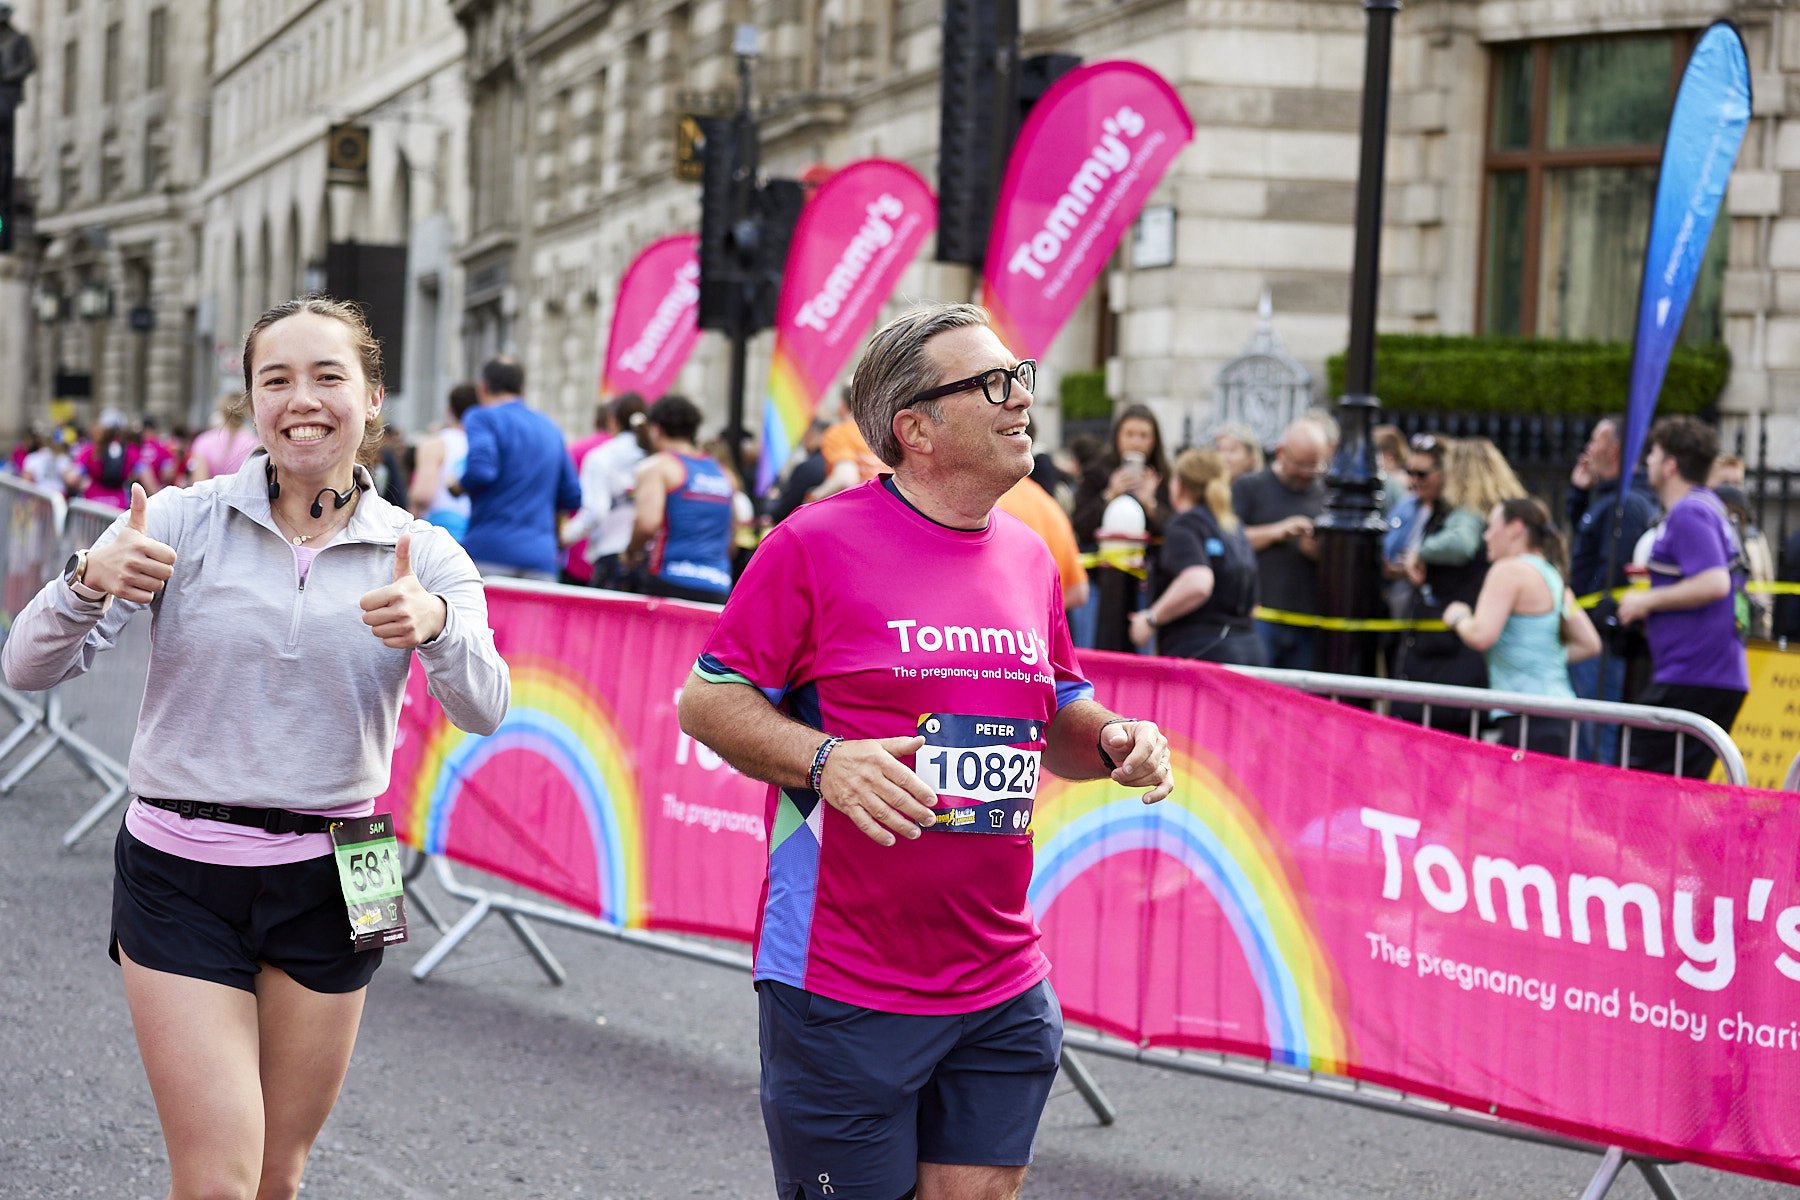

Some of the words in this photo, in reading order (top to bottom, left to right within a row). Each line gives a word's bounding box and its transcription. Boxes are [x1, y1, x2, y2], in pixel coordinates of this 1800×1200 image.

[1007, 105, 1146, 281] Tommy's
[795, 193, 903, 332] Tommy's
[887, 619, 1049, 666] Tommy's
[892, 666, 917, 678] The
[921, 667, 979, 680] pregnancy
[981, 668, 1001, 679] and
[1004, 668, 1031, 683] baby
[975, 723, 1015, 737] PETER
[929, 751, 1036, 794] 10823
[369, 821, 385, 835] SAM
[1359, 807, 1800, 992] Tommy's
[1365, 931, 1411, 968] The
[1417, 952, 1557, 1011] pregnancy
[1564, 985, 1620, 1019] and
[1628, 991, 1708, 1042] baby
[1717, 1011, 1800, 1051] chari
